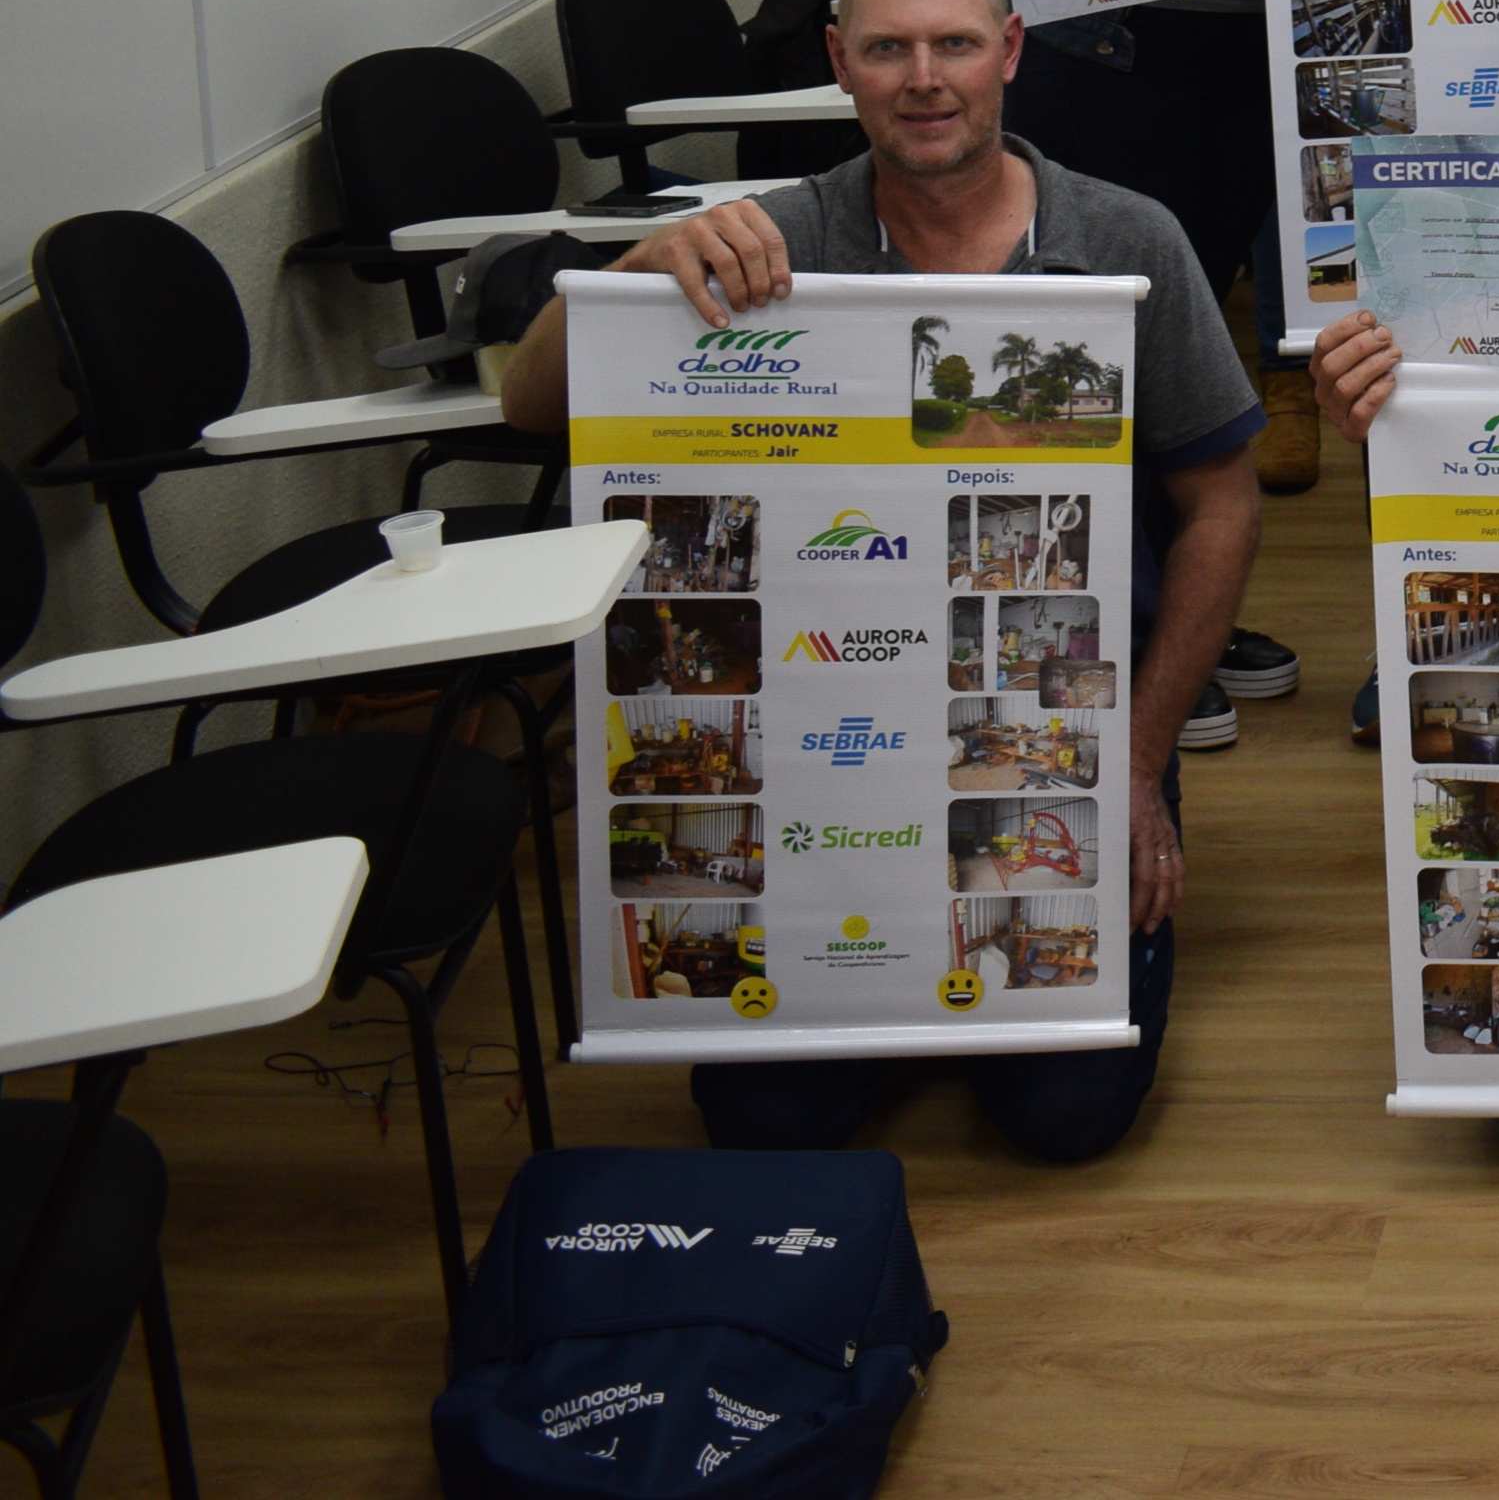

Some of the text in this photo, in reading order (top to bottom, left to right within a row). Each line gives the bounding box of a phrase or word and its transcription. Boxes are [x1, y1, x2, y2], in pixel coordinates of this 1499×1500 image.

[649, 380, 839, 397] Na Qualidade Rural
[730, 422, 839, 439] SCHOVANZ
[765, 443, 800, 458] Jair
[602, 469, 662, 486] Antes:
[946, 468, 1015, 486] Depois:
[1442, 462, 1470, 476] Na
[796, 535, 908, 561] COOPER A1
[1402, 546, 1457, 563] Antes:
[841, 628, 929, 646] AURORA
[841, 646, 901, 663] COOP
[801, 730, 907, 751] SEBRAE
[820, 824, 923, 849] Sicredi
[826, 941, 887, 952] SESCOOP
[577, 1222, 648, 1237] COOP
[544, 1235, 644, 1252] AURORA
[751, 1234, 838, 1250] SEBRAE
[541, 1382, 643, 1424] PRODUTIVO
